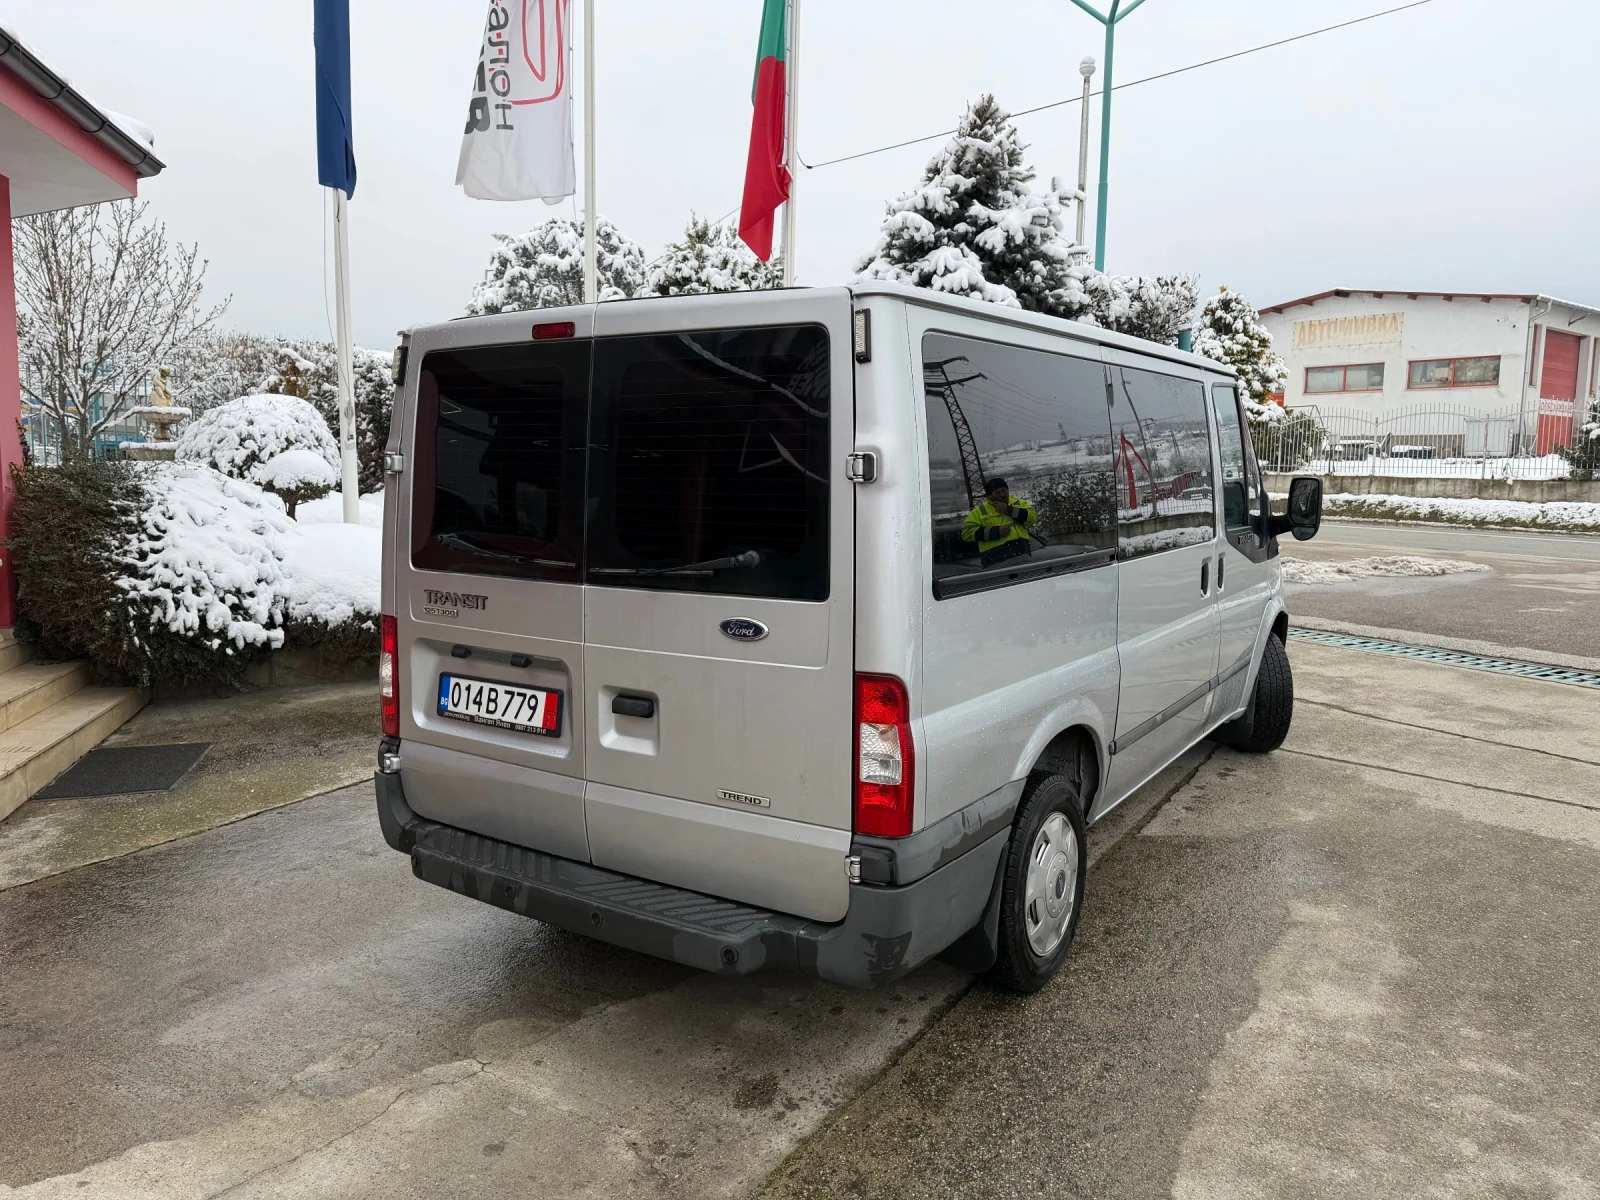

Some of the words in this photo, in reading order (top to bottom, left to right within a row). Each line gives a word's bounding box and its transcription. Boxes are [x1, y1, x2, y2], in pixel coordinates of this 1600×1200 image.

[1296, 314, 1399, 348] АВТОМИВКА
[424, 589, 489, 610] TRANSIT
[727, 620, 755, 636] Ford
[440, 696, 449, 706] BG
[722, 791, 762, 805] TREND
